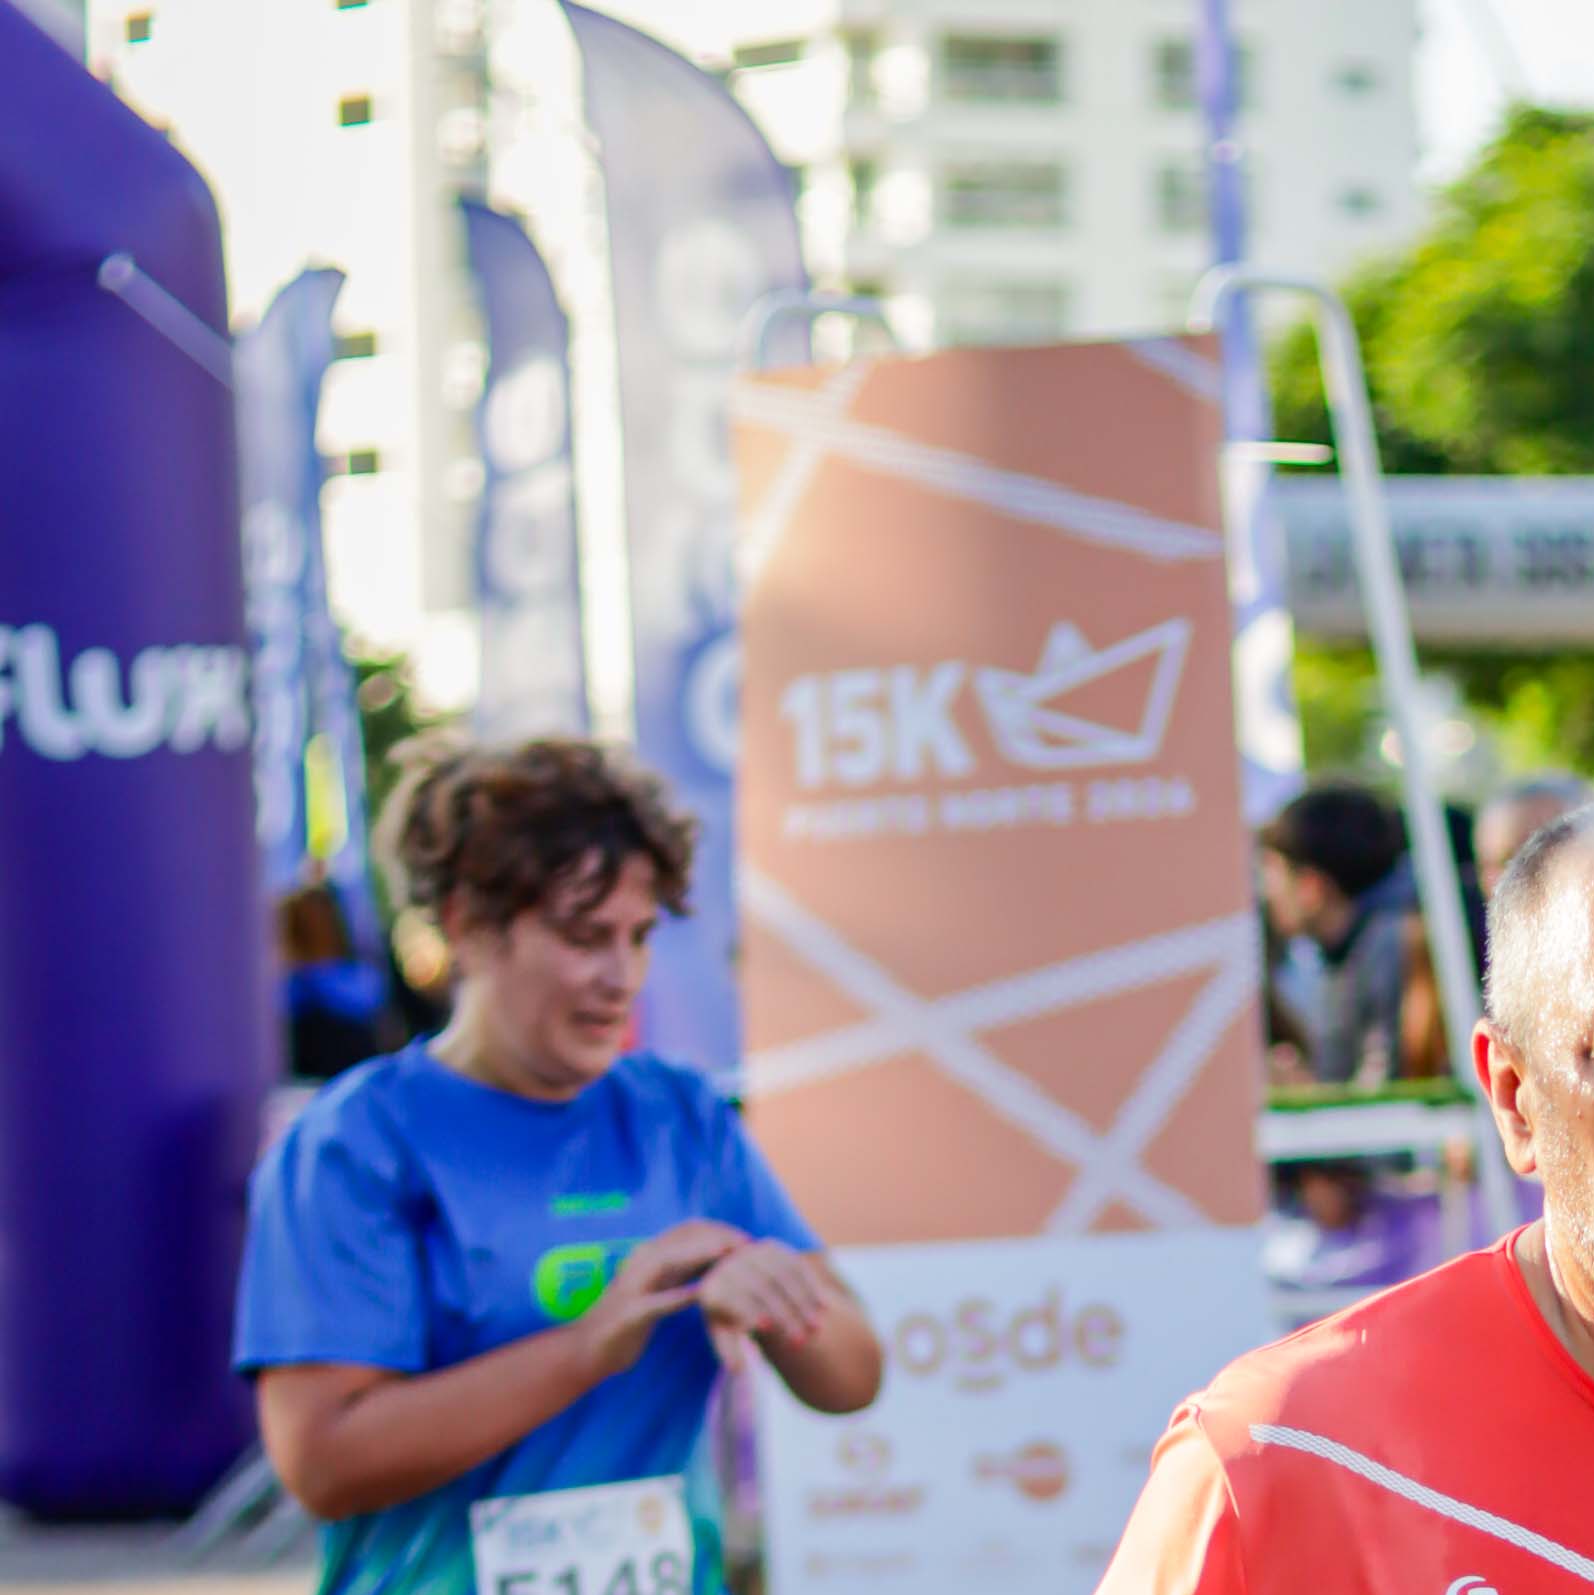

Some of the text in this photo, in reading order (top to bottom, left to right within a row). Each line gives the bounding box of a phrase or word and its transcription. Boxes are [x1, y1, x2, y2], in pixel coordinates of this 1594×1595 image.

[0, 622, 250, 762] lux
[782, 661, 975, 788] 15K
[895, 1285, 1125, 1393] osde
